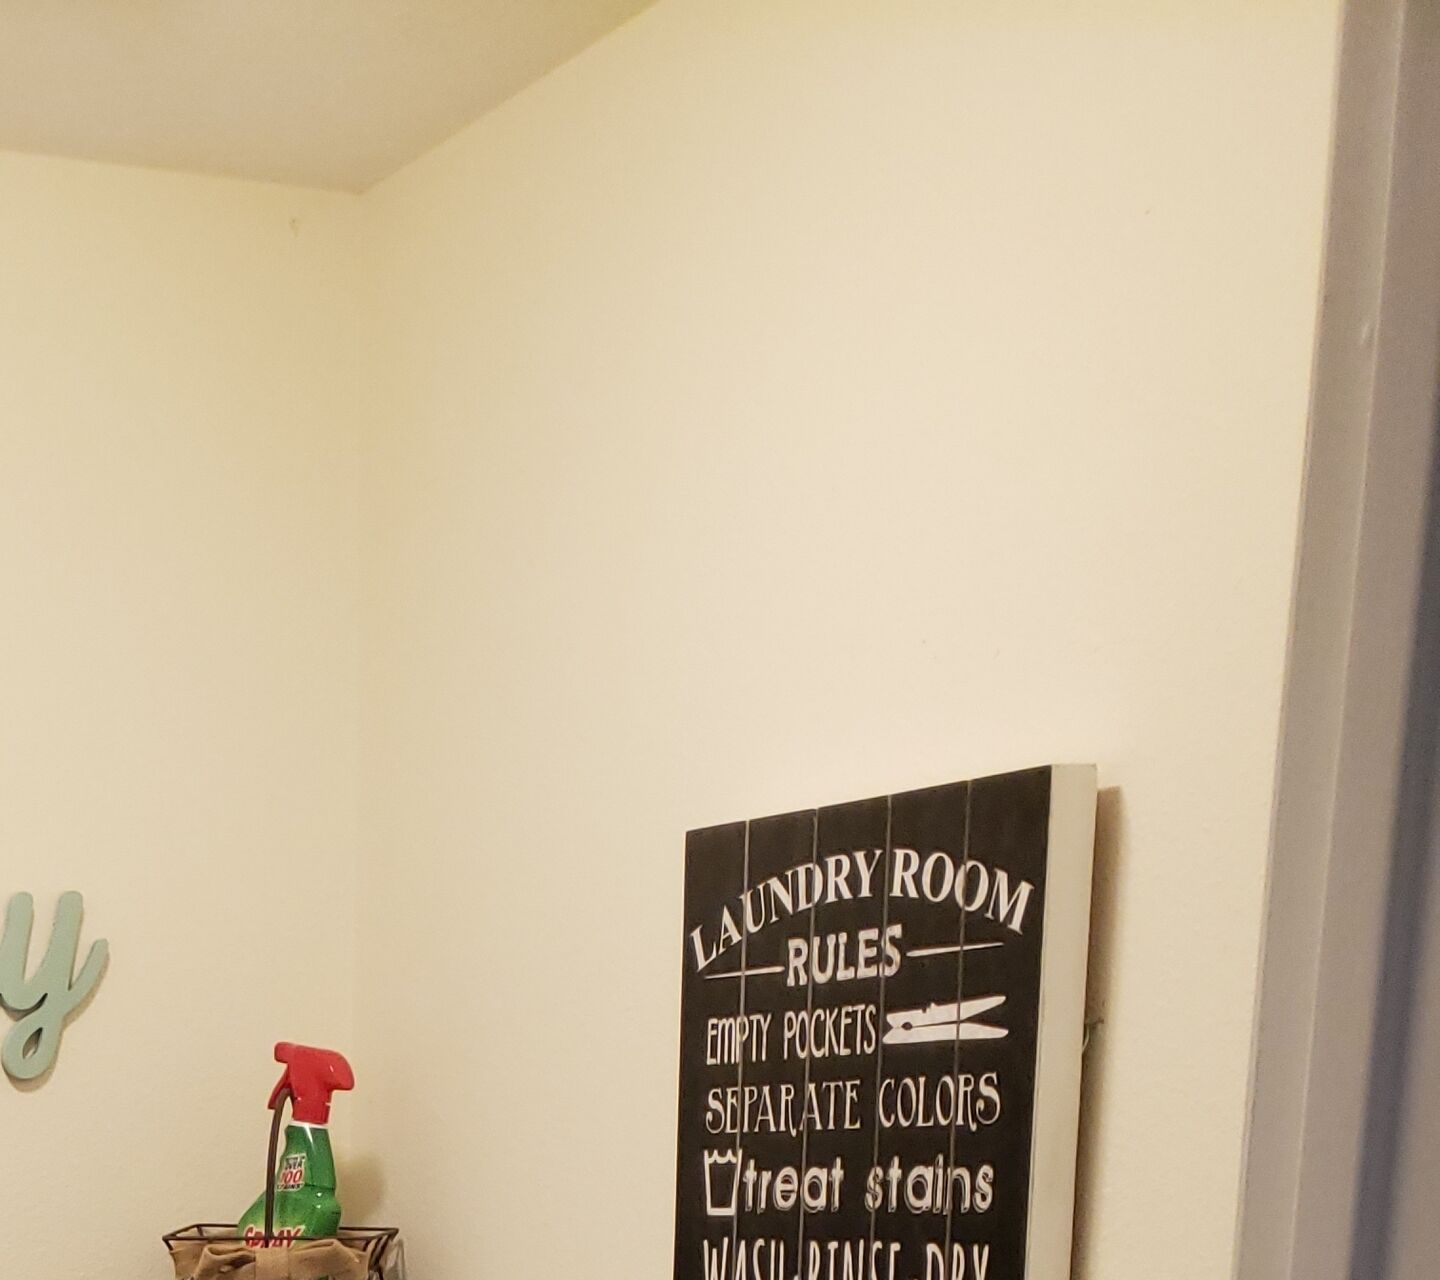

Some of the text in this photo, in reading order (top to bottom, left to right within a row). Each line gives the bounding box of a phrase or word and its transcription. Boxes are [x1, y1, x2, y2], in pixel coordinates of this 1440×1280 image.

[690, 848, 1035, 972] LAUNDRY ROOM
[786, 923, 903, 987] RULES
[705, 1004, 877, 1065] EMPTY POCKETS
[705, 1072, 1002, 1136] SEPARATE COLORS
[742, 1153, 995, 1215] treat stains
[245, 1226, 302, 1248] SPAY
